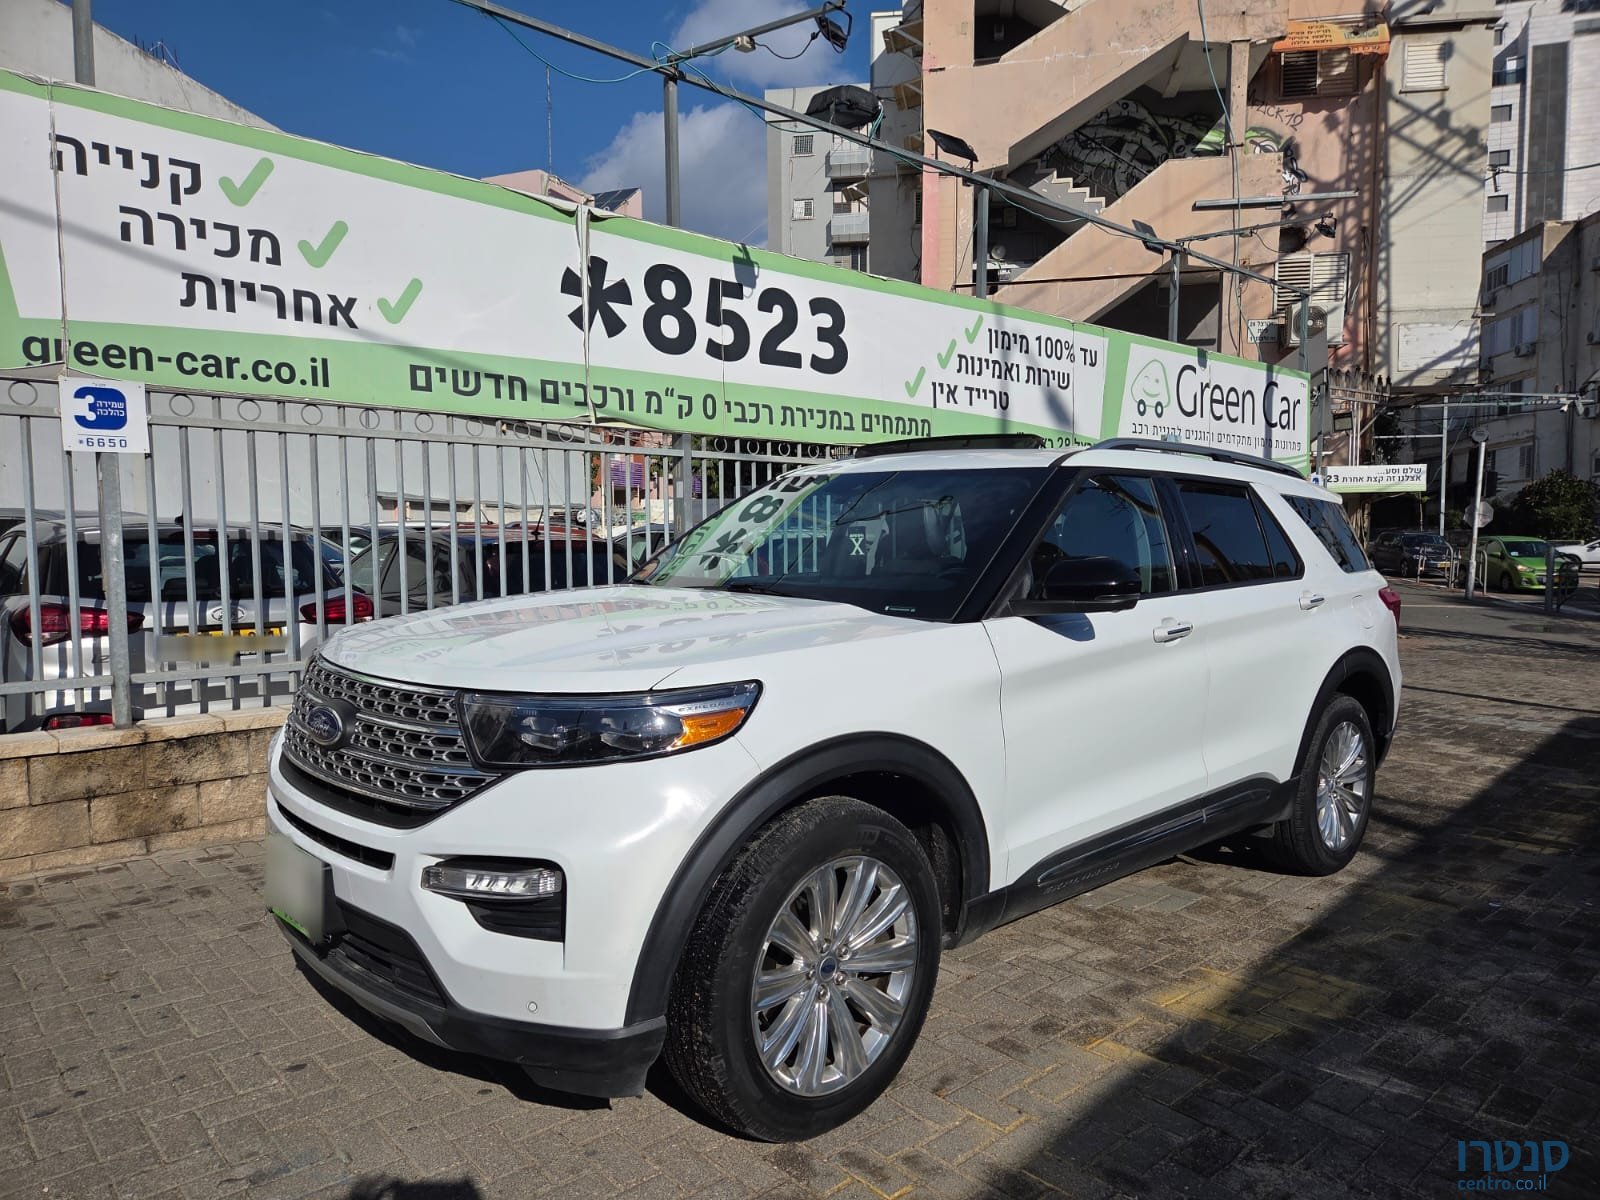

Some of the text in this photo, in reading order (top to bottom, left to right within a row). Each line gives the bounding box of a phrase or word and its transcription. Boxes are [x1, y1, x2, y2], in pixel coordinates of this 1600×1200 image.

[49, 133, 202, 206] קנייה
[118, 204, 282, 266] מכירה
[180, 272, 359, 329] אחריות
[22, 335, 330, 388] green-car.co.il
[987, 328, 1098, 367] עד 100% מימון
[409, 364, 529, 402] חדשים
[956, 353, 1071, 390] שירות ואמינות
[96, 401, 124, 409] שמירה
[540, 377, 635, 411] ורכבים
[702, 392, 717, 420] 0
[931, 381, 1010, 411] טרייד אין
[1176, 364, 1301, 431] Green Car
[96, 408, 125, 417] כהלכה
[725, 400, 774, 426] רכבי
[780, 404, 854, 433] במכירת
[862, 413, 932, 439] מתמחים
[1131, 422, 1149, 436] רכב
[1185, 428, 1214, 443] והוגנים
[1217, 432, 1252, 448] מתקדמים
[1254, 436, 1273, 450] מימון
[1274, 438, 1302, 451] פתרונות
